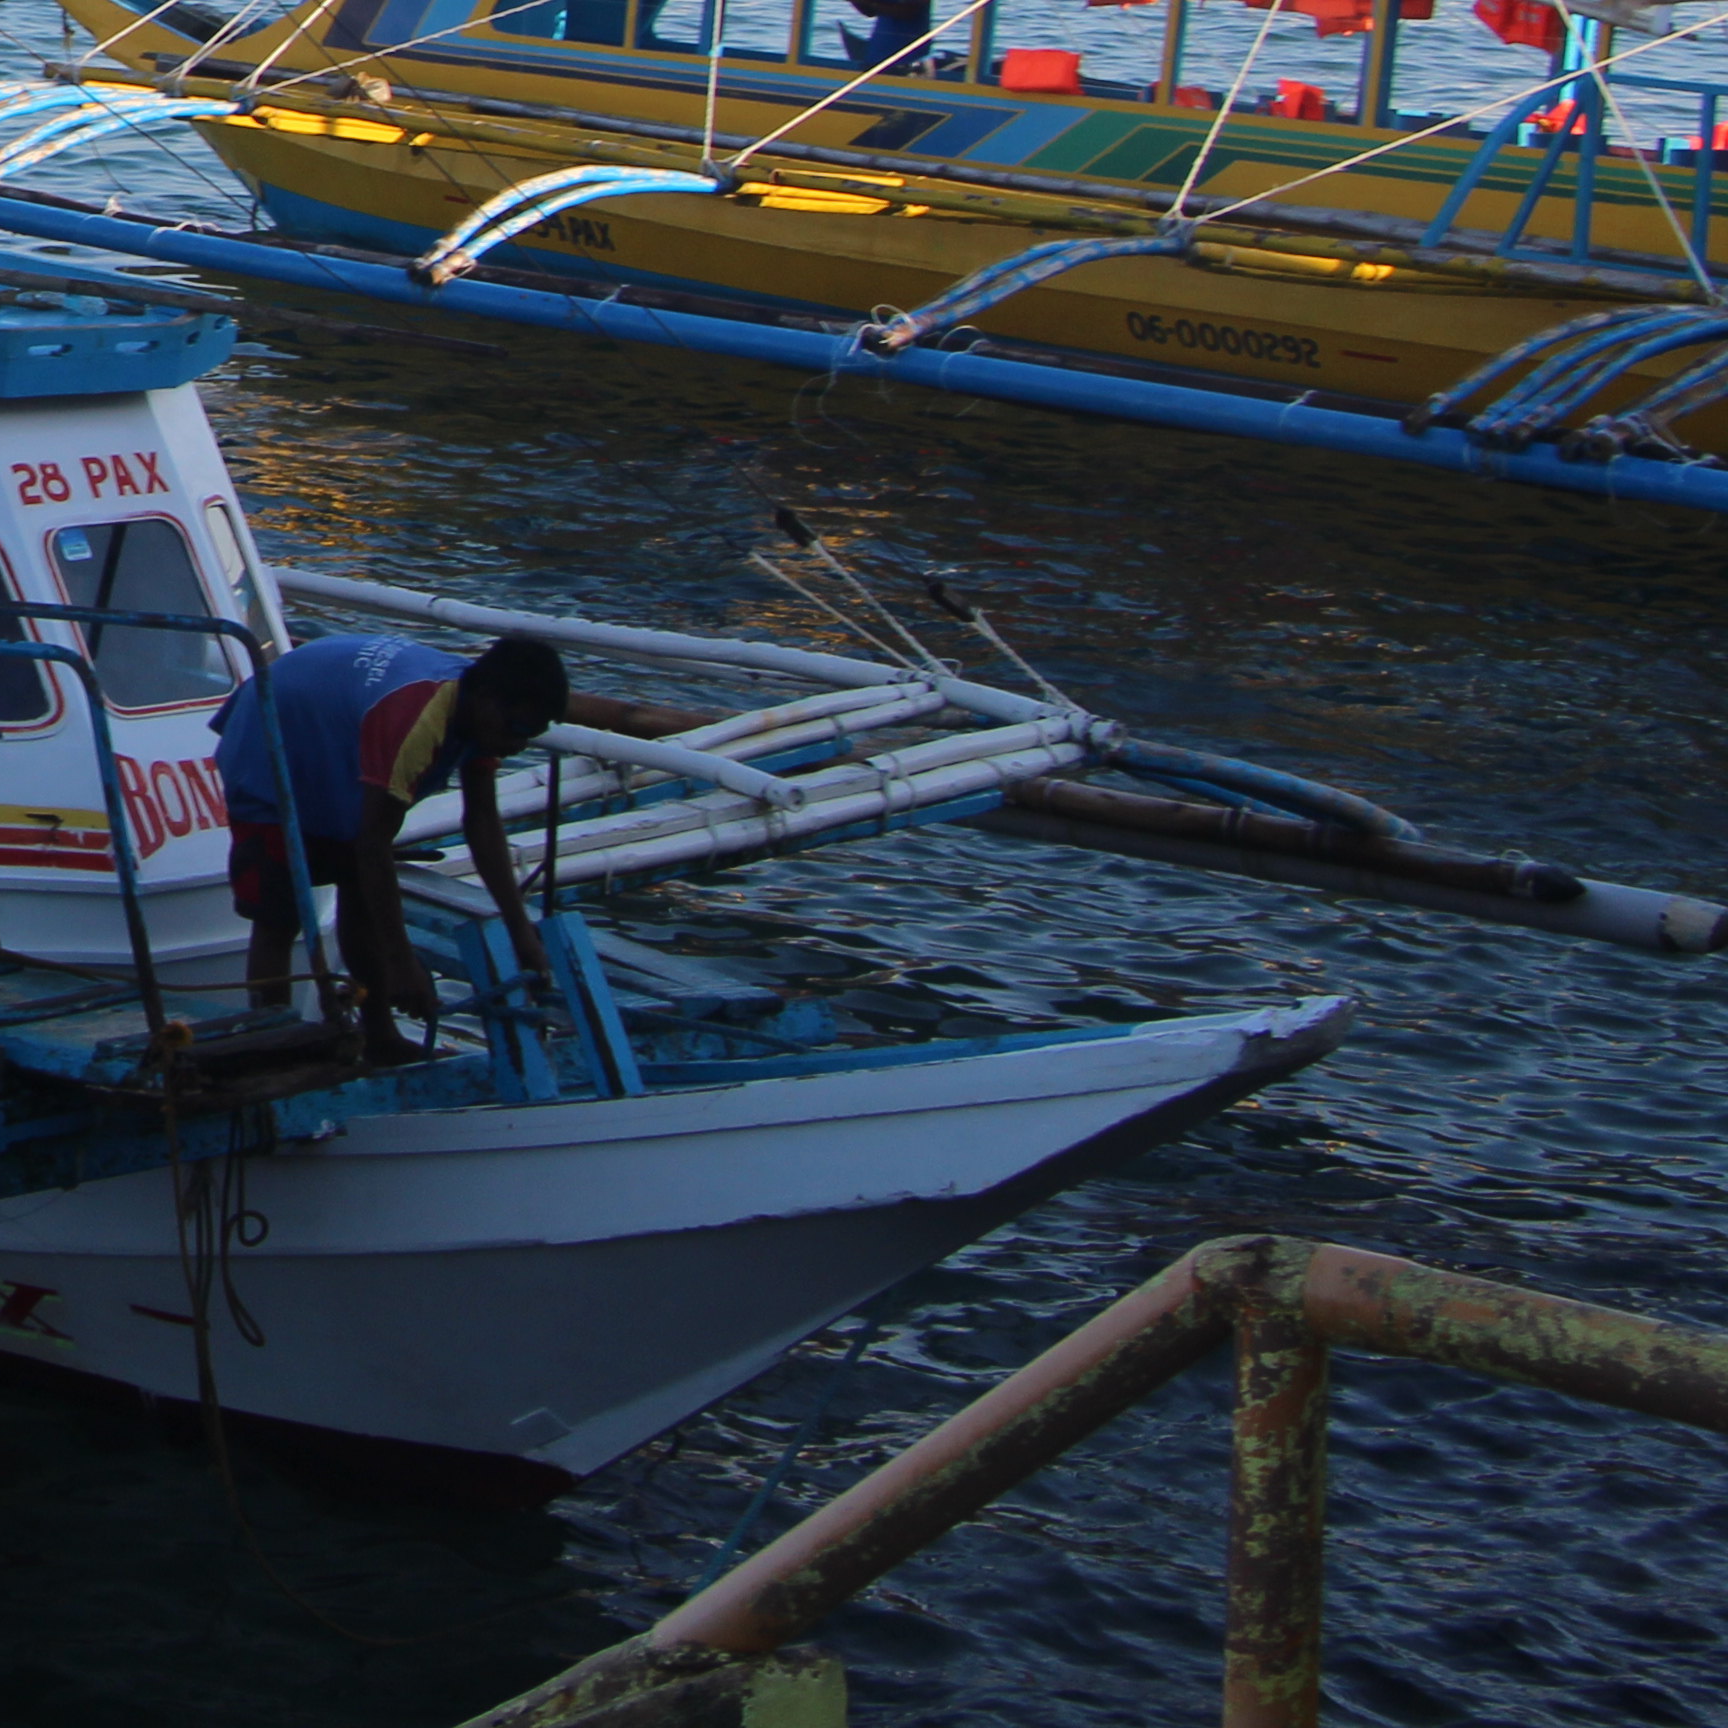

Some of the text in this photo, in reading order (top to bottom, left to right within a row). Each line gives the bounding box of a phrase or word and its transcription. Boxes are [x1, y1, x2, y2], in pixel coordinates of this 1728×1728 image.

[568, 216, 616, 251] PAX
[1126, 311, 1322, 370] 06-0000292
[11, 451, 171, 506] 28 PAX
